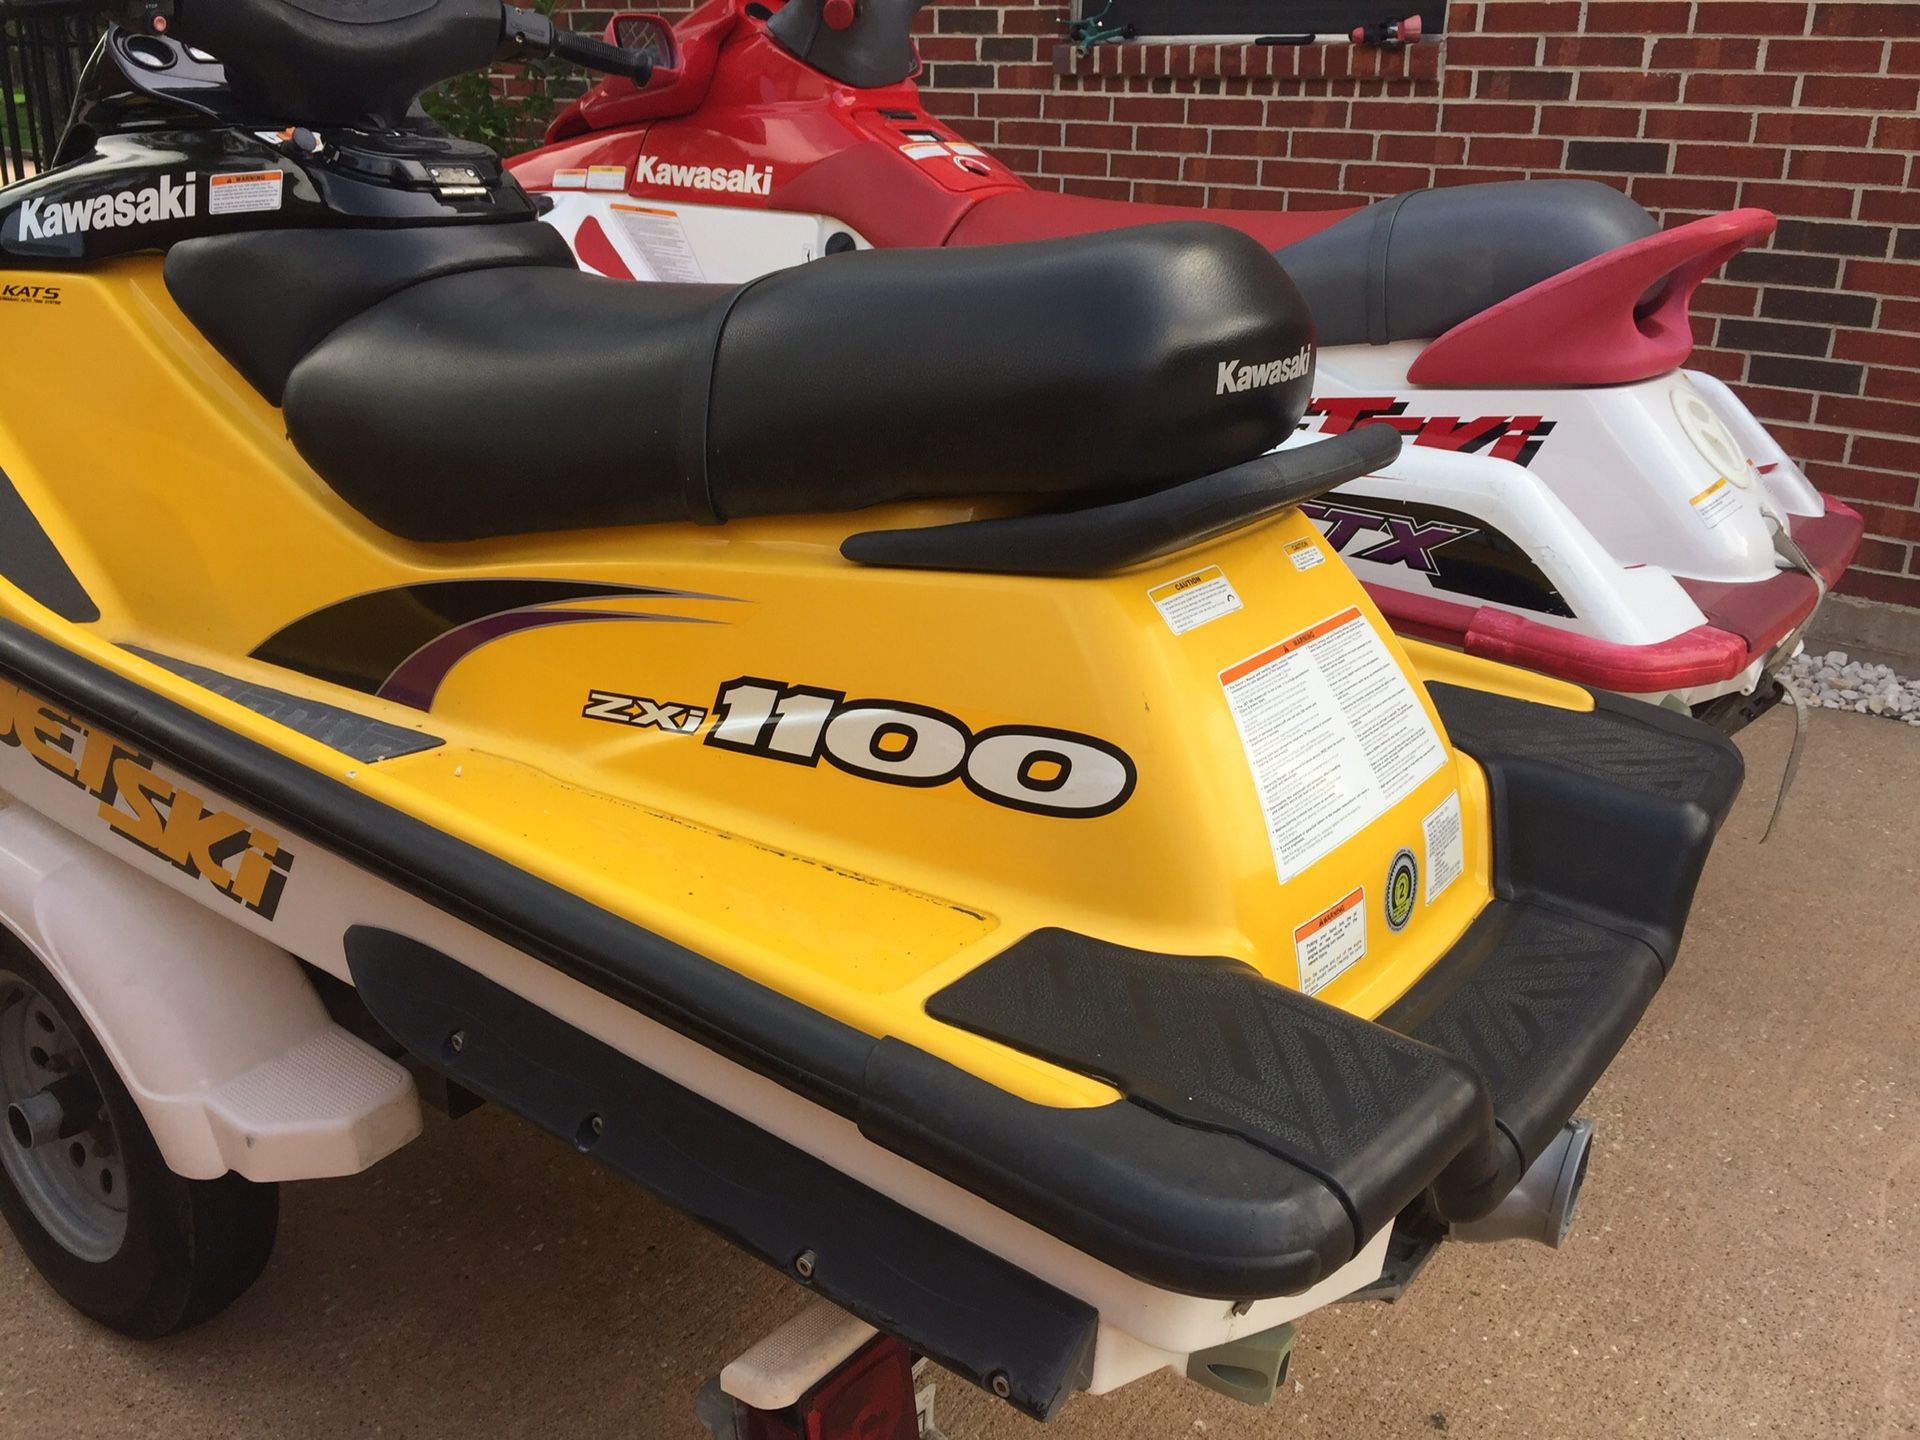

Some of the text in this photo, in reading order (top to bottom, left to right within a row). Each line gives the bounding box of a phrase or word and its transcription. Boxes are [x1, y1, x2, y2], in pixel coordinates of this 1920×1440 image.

[235, 174, 266, 182] WARNING
[636, 154, 774, 196] Kawasaki
[18, 170, 197, 242] Kawasaki
[2, 284, 62, 300] KATS
[1215, 343, 1312, 396] Kawasaki
[1174, 575, 1202, 591] CAUTION
[1291, 630, 1316, 647] WARNING
[703, 675, 1137, 818] 1100
